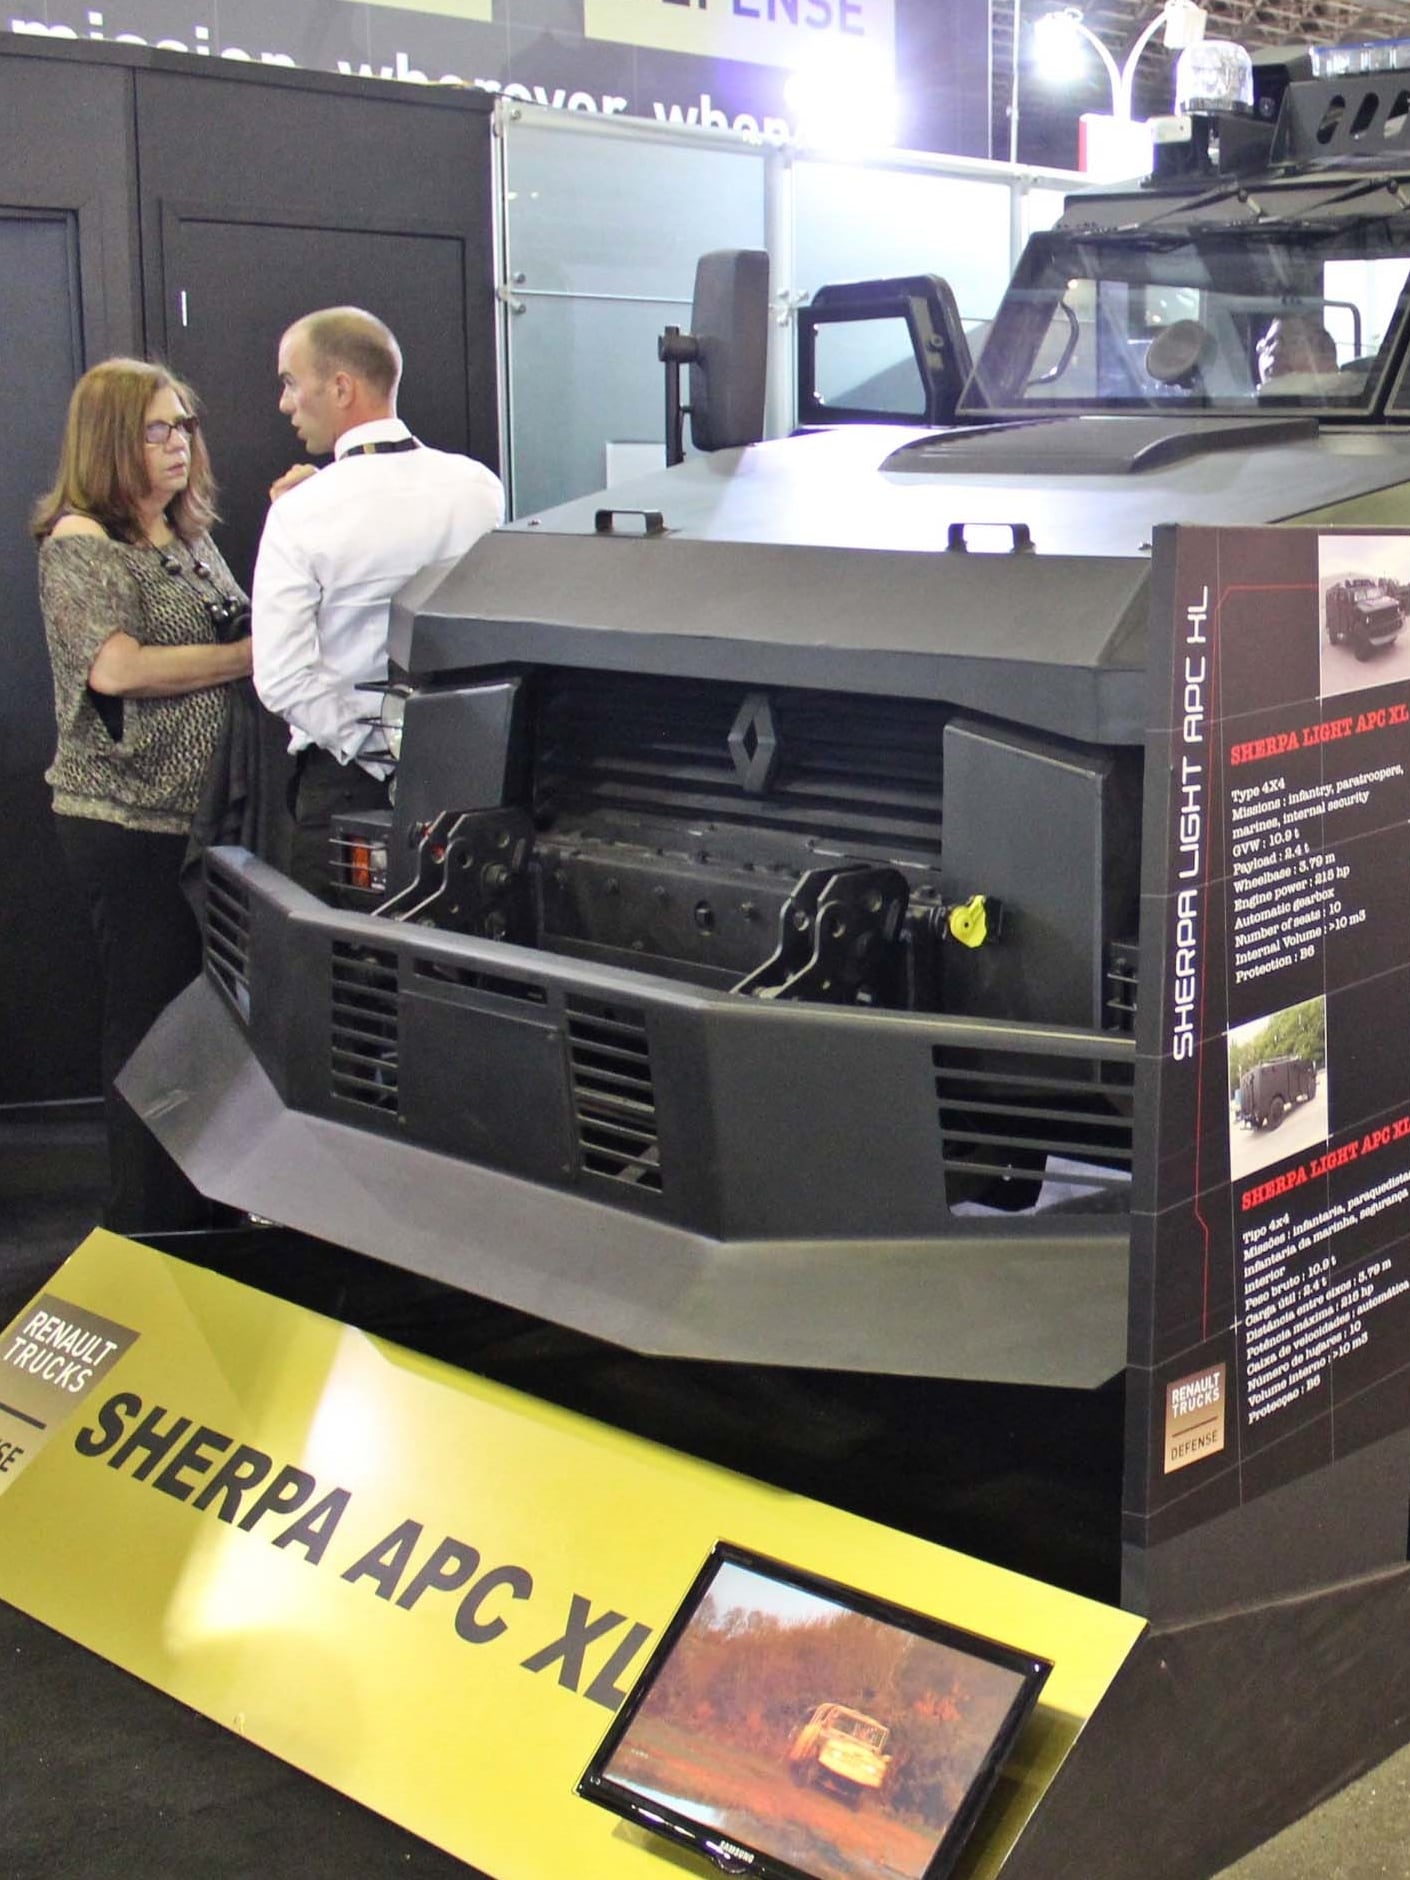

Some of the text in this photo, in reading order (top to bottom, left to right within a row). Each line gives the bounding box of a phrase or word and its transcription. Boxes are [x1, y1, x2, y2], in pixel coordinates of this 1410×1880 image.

[1184, 656, 1206, 743] APC
[1230, 703, 1410, 766] SHERPA LIGHT APC XL
[1231, 777, 1286, 803] Type 4X4
[1232, 797, 1281, 821] Missions
[1288, 783, 1335, 806] infantry,
[1336, 764, 1404, 792] paratroopers,
[1232, 789, 1370, 840] marines, internal security
[1180, 755, 1202, 879] LIGHT
[1232, 839, 1260, 858] GVW
[1269, 829, 1293, 848] 10.9
[1294, 827, 1300, 839] t
[1232, 852, 1277, 877] Payload
[1284, 844, 1302, 860] 2.4
[1303, 842, 1310, 854] t
[1233, 866, 1292, 894] Wheelbase
[1325, 852, 1336, 865] m
[1233, 891, 1273, 913] Engine
[1274, 878, 1308, 900] power
[1314, 868, 1335, 886] 215
[1336, 864, 1350, 879] hp
[1234, 886, 1335, 931] Automatic gearbox
[1235, 924, 1279, 948] Number
[1281, 917, 1293, 932] of
[1294, 908, 1321, 926] seats
[1329, 900, 1342, 916] 10
[1235, 939, 1280, 967] Internal
[1282, 926, 1322, 949] Volume
[1329, 916, 1348, 932] >10
[1235, 954, 1293, 984] Protection
[1300, 945, 1315, 960] B6
[1173, 890, 1198, 1061] SHERPA
[1241, 1166, 1308, 1212] SHERPA
[1310, 1140, 1360, 1177] LIGHT
[1361, 1128, 1391, 1155] APC
[1242, 1212, 1290, 1245] Tipo 4x4
[1293, 1203, 1347, 1237] infantaria,
[1244, 1245, 1298, 1278] infantaria
[1298, 1238, 1313, 1252] da
[1313, 1214, 1359, 1244] marinha,
[1244, 1265, 1287, 1295] interior
[1245, 1289, 1270, 1312] Peso
[1271, 1273, 1301, 1297] bruto
[1245, 1304, 1277, 1327] Carga
[1303, 1278, 1320, 1297] 2.4
[1296, 1295, 1324, 1316] entre
[1325, 1278, 1353, 1301] eixos
[1382, 1258, 1392, 1271] m
[1360, 1283, 1375, 1300] hp
[23, 1310, 118, 1367] RENAULT
[1247, 1351, 1278, 1376] Caixa
[1278, 1343, 1292, 1359] de
[1294, 1311, 1350, 1351] velocidades
[1291, 1354, 1305, 1370] de
[1305, 1331, 1343, 1361] lugares
[1349, 1320, 1362, 1336] 10
[3, 1336, 93, 1393] TRUCKS
[1171, 1371, 1220, 1404] RENAULT
[1248, 1378, 1287, 1408] Volume
[1288, 1355, 1327, 1382] interno
[1171, 1387, 1220, 1419] TRUCKS
[1170, 1430, 1219, 1461] DEFENSE
[74, 1392, 653, 1713] SHERPA APC XL
[720, 1840, 755, 1864] SAMSUNG
